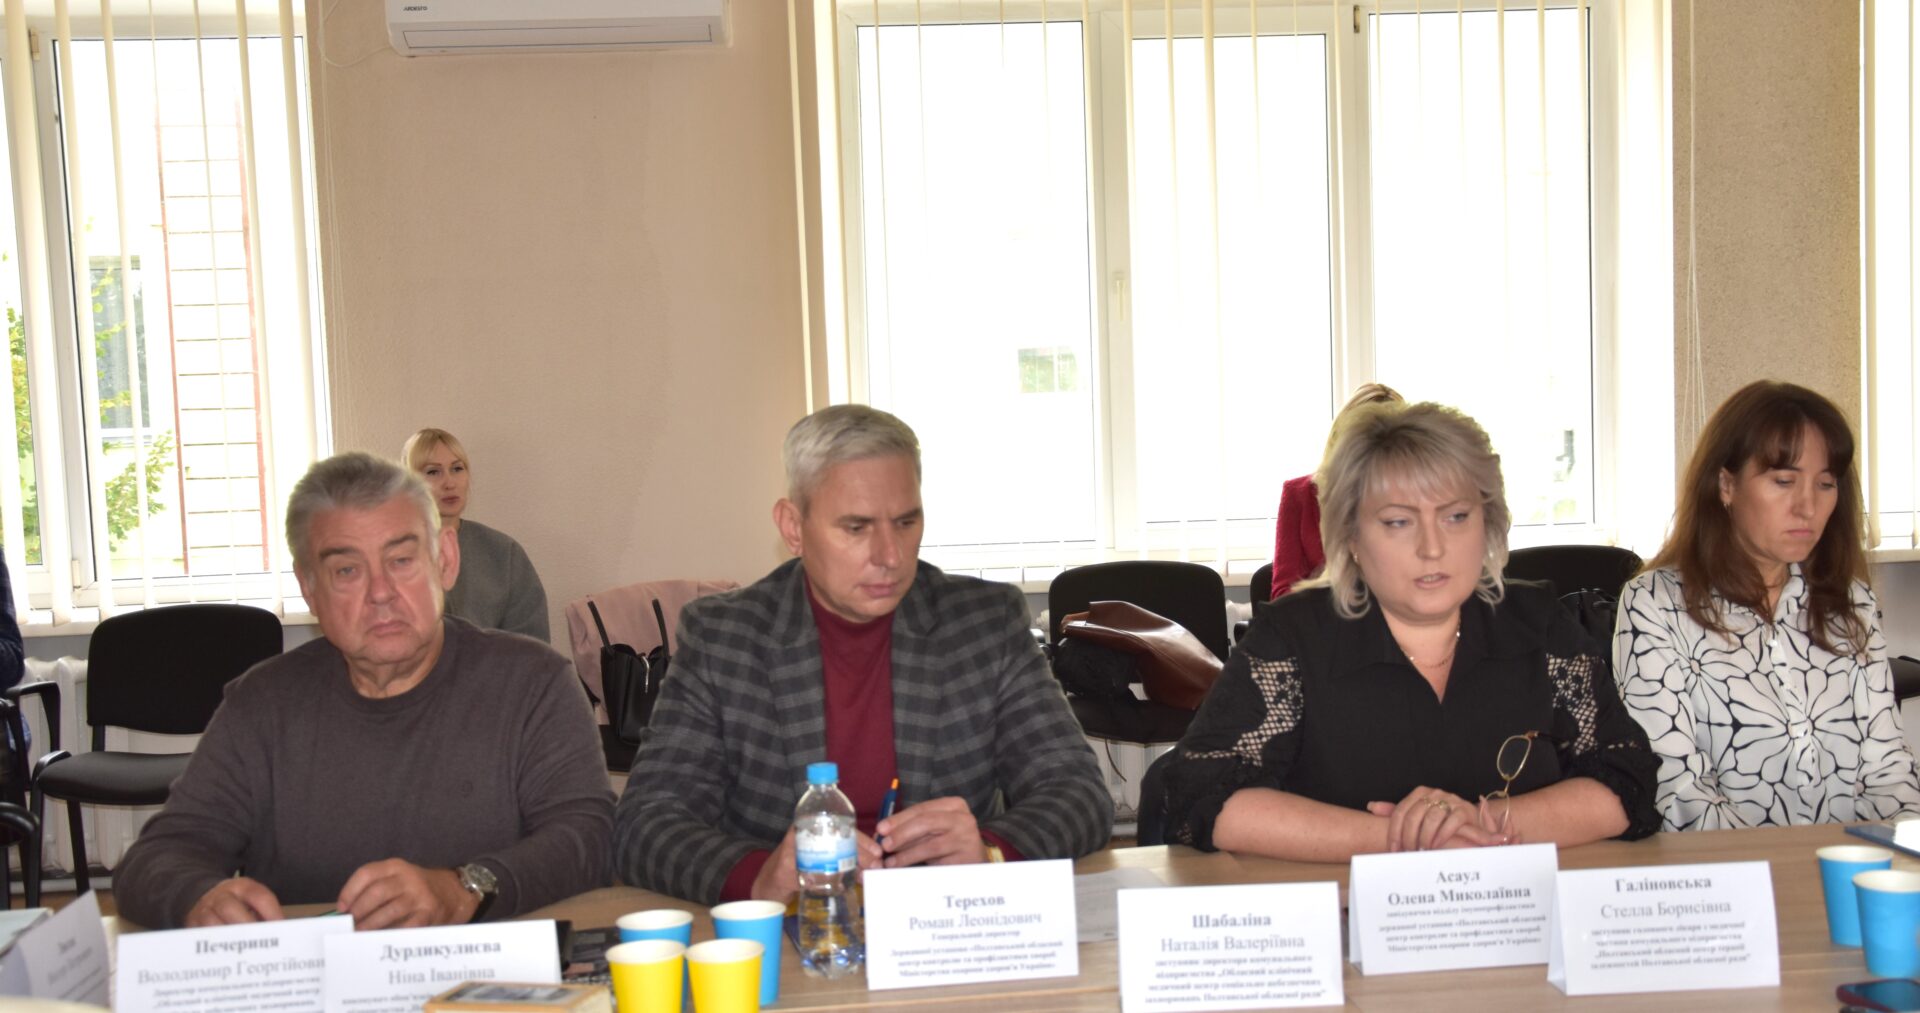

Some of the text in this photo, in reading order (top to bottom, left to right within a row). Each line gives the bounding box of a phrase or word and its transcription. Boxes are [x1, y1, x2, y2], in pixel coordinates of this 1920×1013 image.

[1436, 870, 1481, 884] Асаул
[1615, 876, 1712, 894] Галіновська
[943, 894, 1006, 911] Терехов
[1387, 886, 1531, 906] Олена Миколаївна
[1600, 900, 1732, 919] Стелла Борисівна
[909, 912, 1043, 930] Роман Леонідович
[1192, 912, 1272, 929] Шабаліна
[195, 937, 280, 955] Печериця
[1161, 934, 1305, 952] Наталія Валеріївна
[137, 956, 326, 985] Володимир Георгійови
[388, 965, 496, 985] Ніна Іванівна
